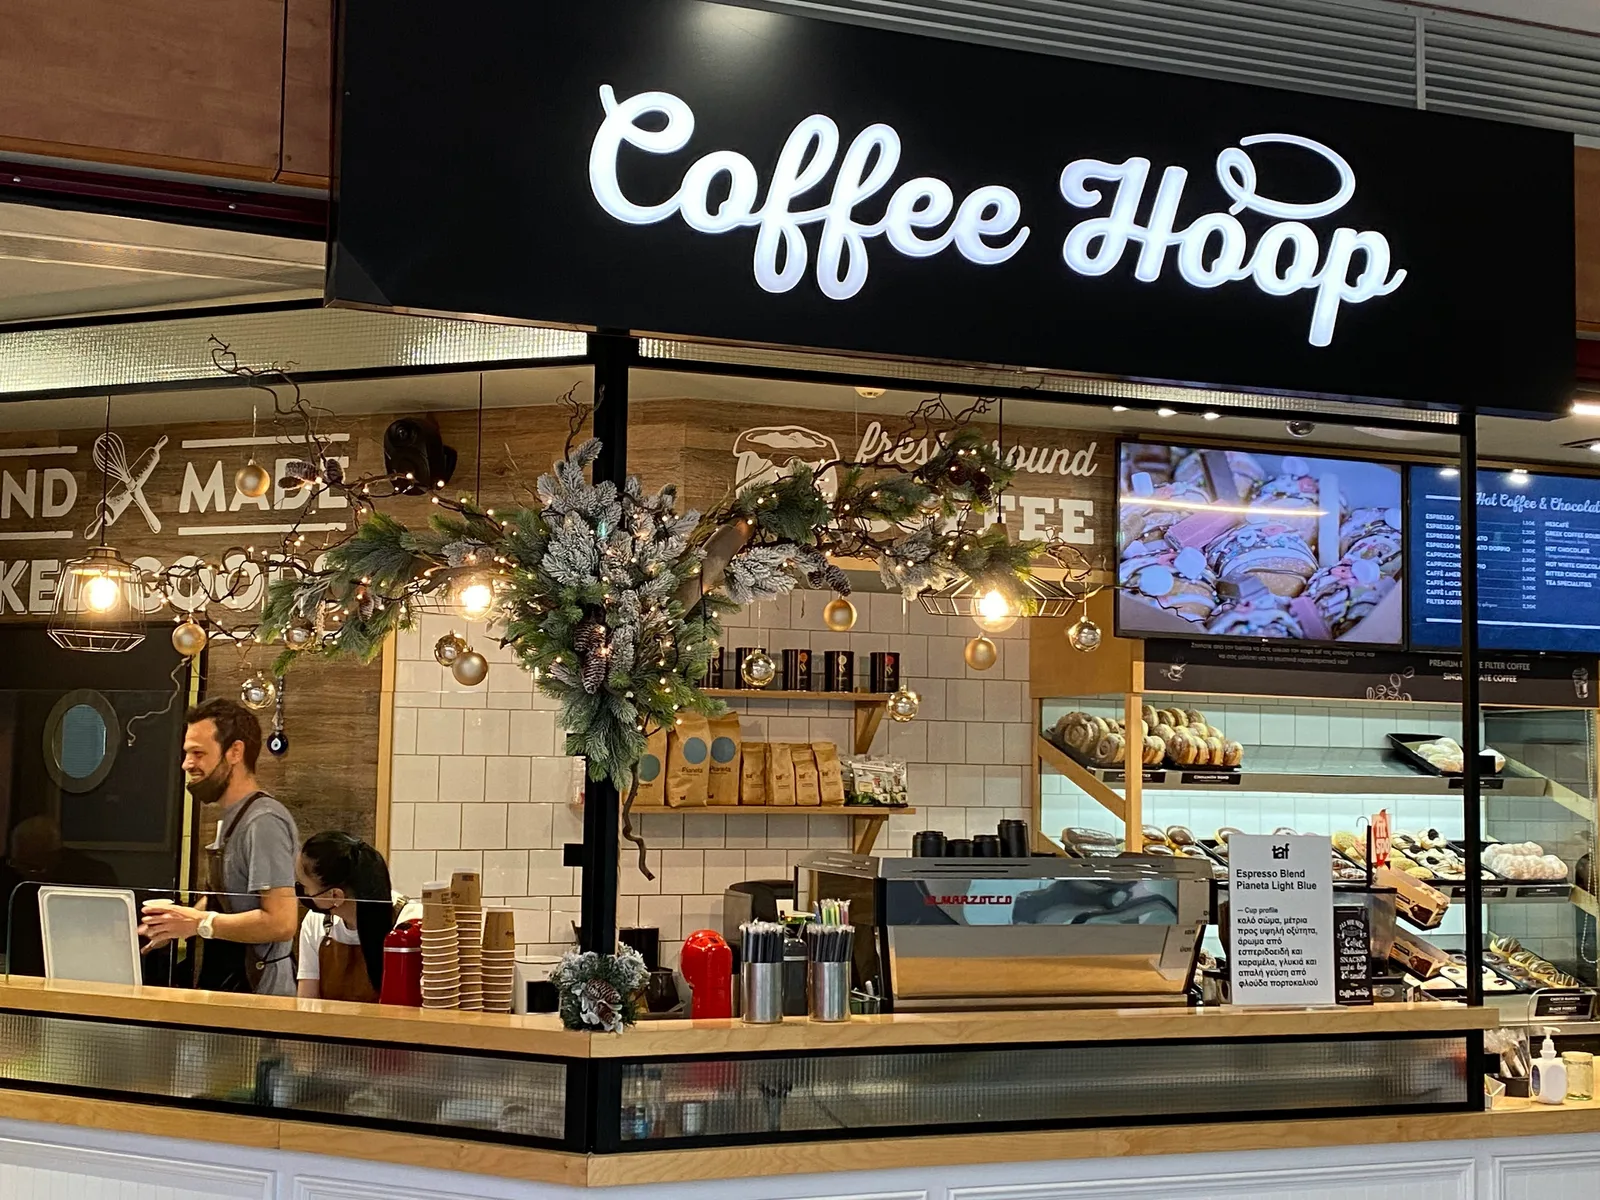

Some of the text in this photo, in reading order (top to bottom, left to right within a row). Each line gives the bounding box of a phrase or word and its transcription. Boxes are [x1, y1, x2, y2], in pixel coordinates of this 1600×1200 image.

[589, 84, 1407, 347] Coffee Hoop
[1476, 492, 1497, 506] Hot
[1500, 494, 1537, 513] Coffee
[1539, 497, 1547, 510] &
[1426, 532, 1454, 540] ESPRESSO
[1558, 546, 1590, 554] CHOCOLATE
[1429, 659, 1458, 668] PREMIUM
[1484, 662, 1505, 670] FILTER
[1506, 663, 1530, 671] COFFEE
[1492, 674, 1517, 682] COFFEE
[681, 766, 703, 774] Pianeta
[1272, 843, 1290, 860] taf
[1236, 869, 1305, 880] Espresso Blend
[1236, 881, 1317, 892] Pianeta Light Blue
[1238, 916, 1308, 925] καλό σώμα, μέτρια
[1238, 927, 1318, 936] προς υψηλή οξύτητα,
[1238, 937, 1282, 946] άρωμα από
[1238, 948, 1290, 956] εσπεριδοειδή
[1238, 958, 1277, 966] καραμέλα,
[1279, 958, 1304, 967] γλυκιά
[1238, 968, 1306, 978] απαλή γεύση από
[1238, 978, 1318, 988] φλούδα πορτοκαλιού
